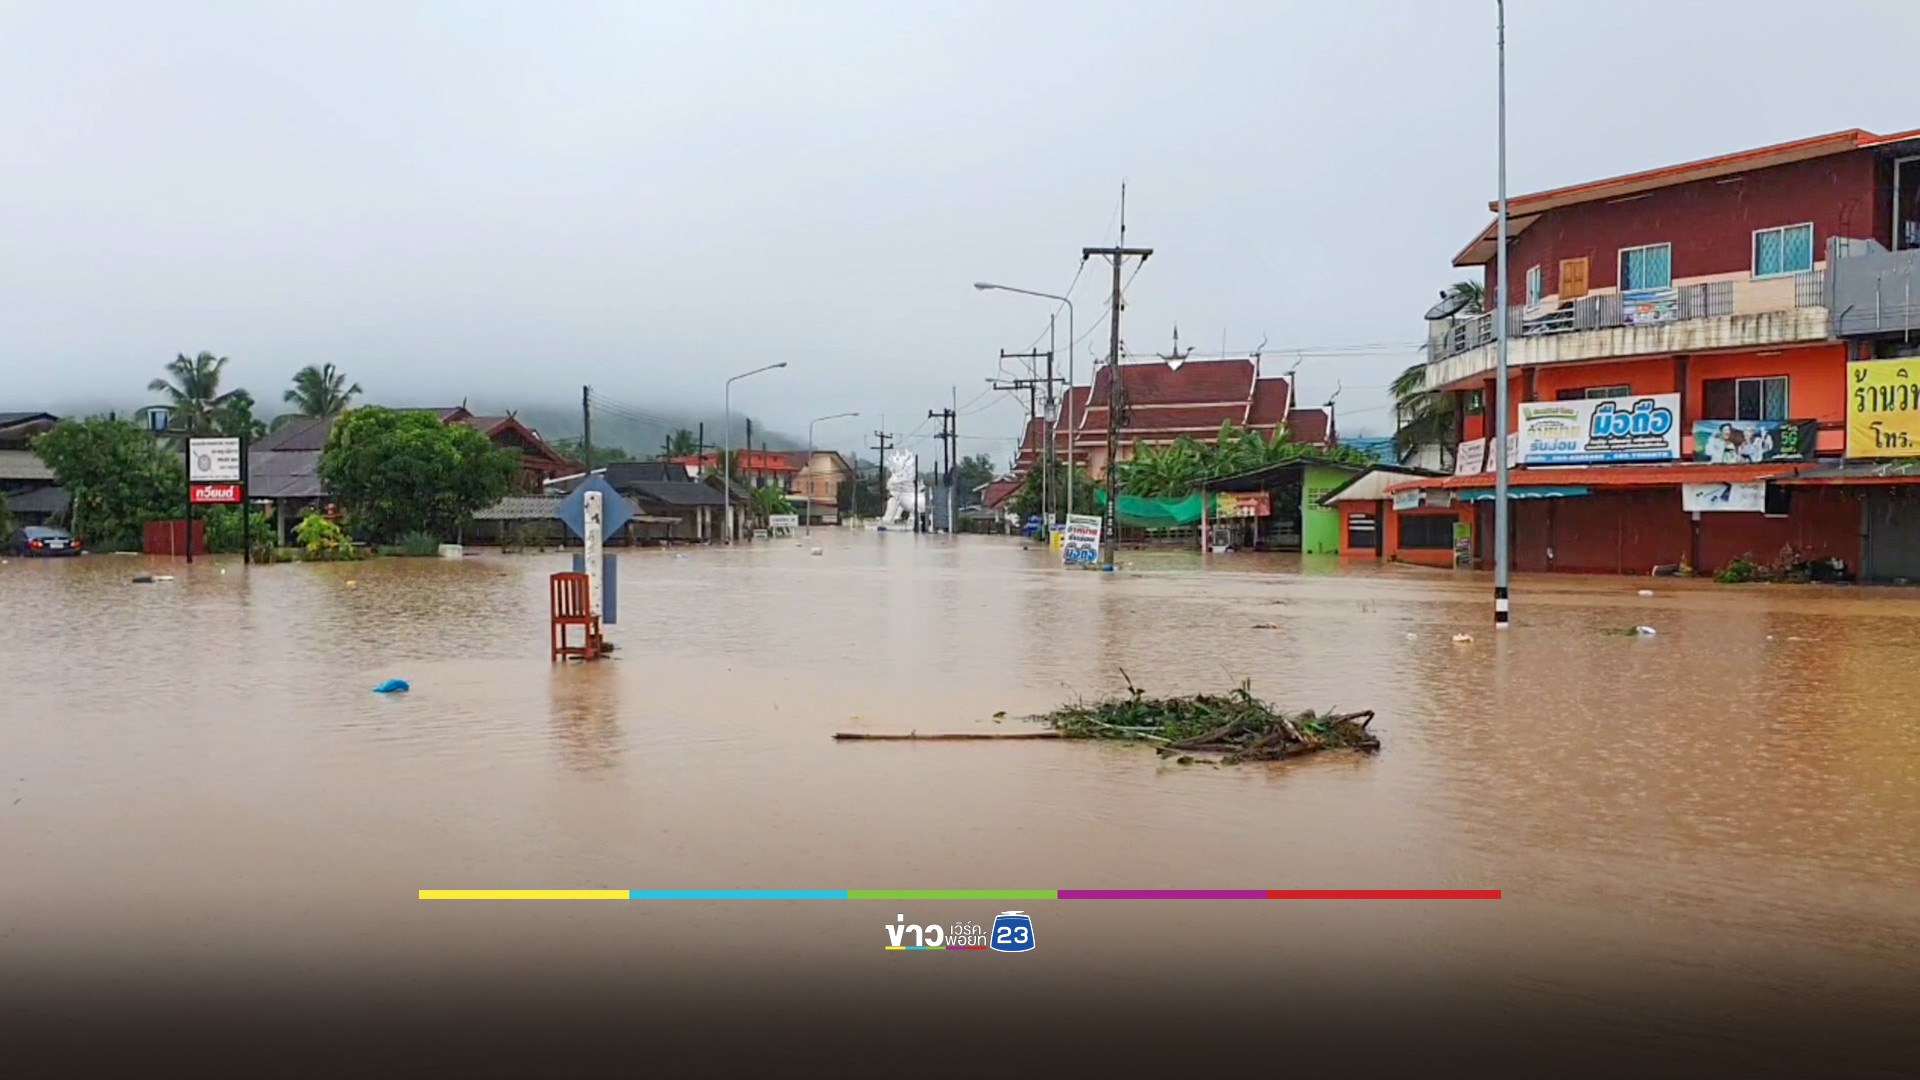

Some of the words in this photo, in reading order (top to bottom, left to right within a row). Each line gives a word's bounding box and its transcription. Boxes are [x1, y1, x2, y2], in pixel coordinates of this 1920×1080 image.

[1591, 400, 1672, 437] มือถือ
[1781, 431, 1798, 445] 5G
[1869, 421, 1913, 448] โทร.
